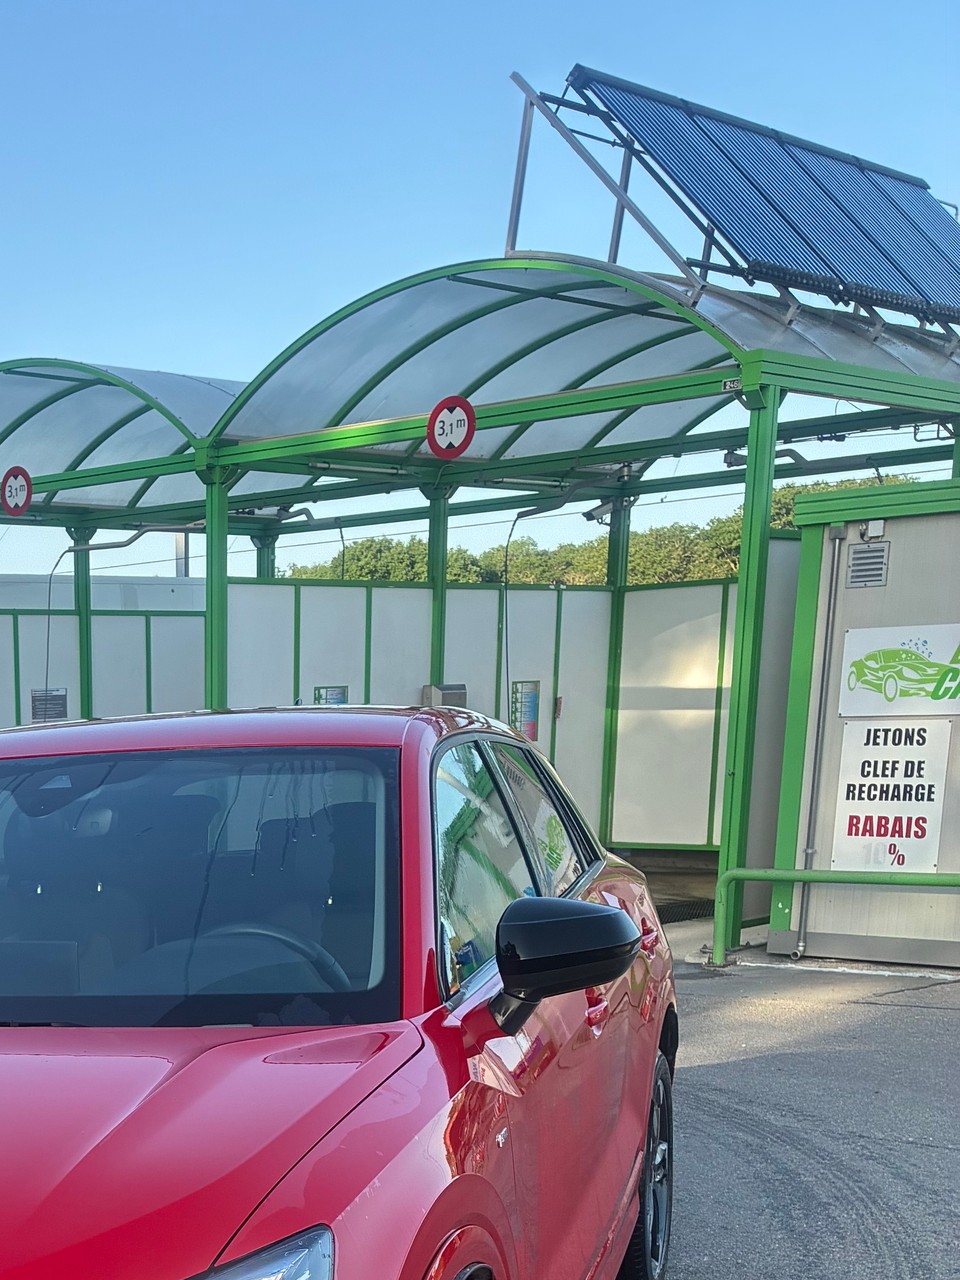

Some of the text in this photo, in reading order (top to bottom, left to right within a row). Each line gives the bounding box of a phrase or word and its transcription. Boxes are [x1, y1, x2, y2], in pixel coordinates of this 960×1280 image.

[864, 727, 927, 746] JETONS
[860, 760, 926, 778] CLEF DE
[845, 783, 935, 802] RECHARGE
[847, 815, 927, 839] RABAIS
